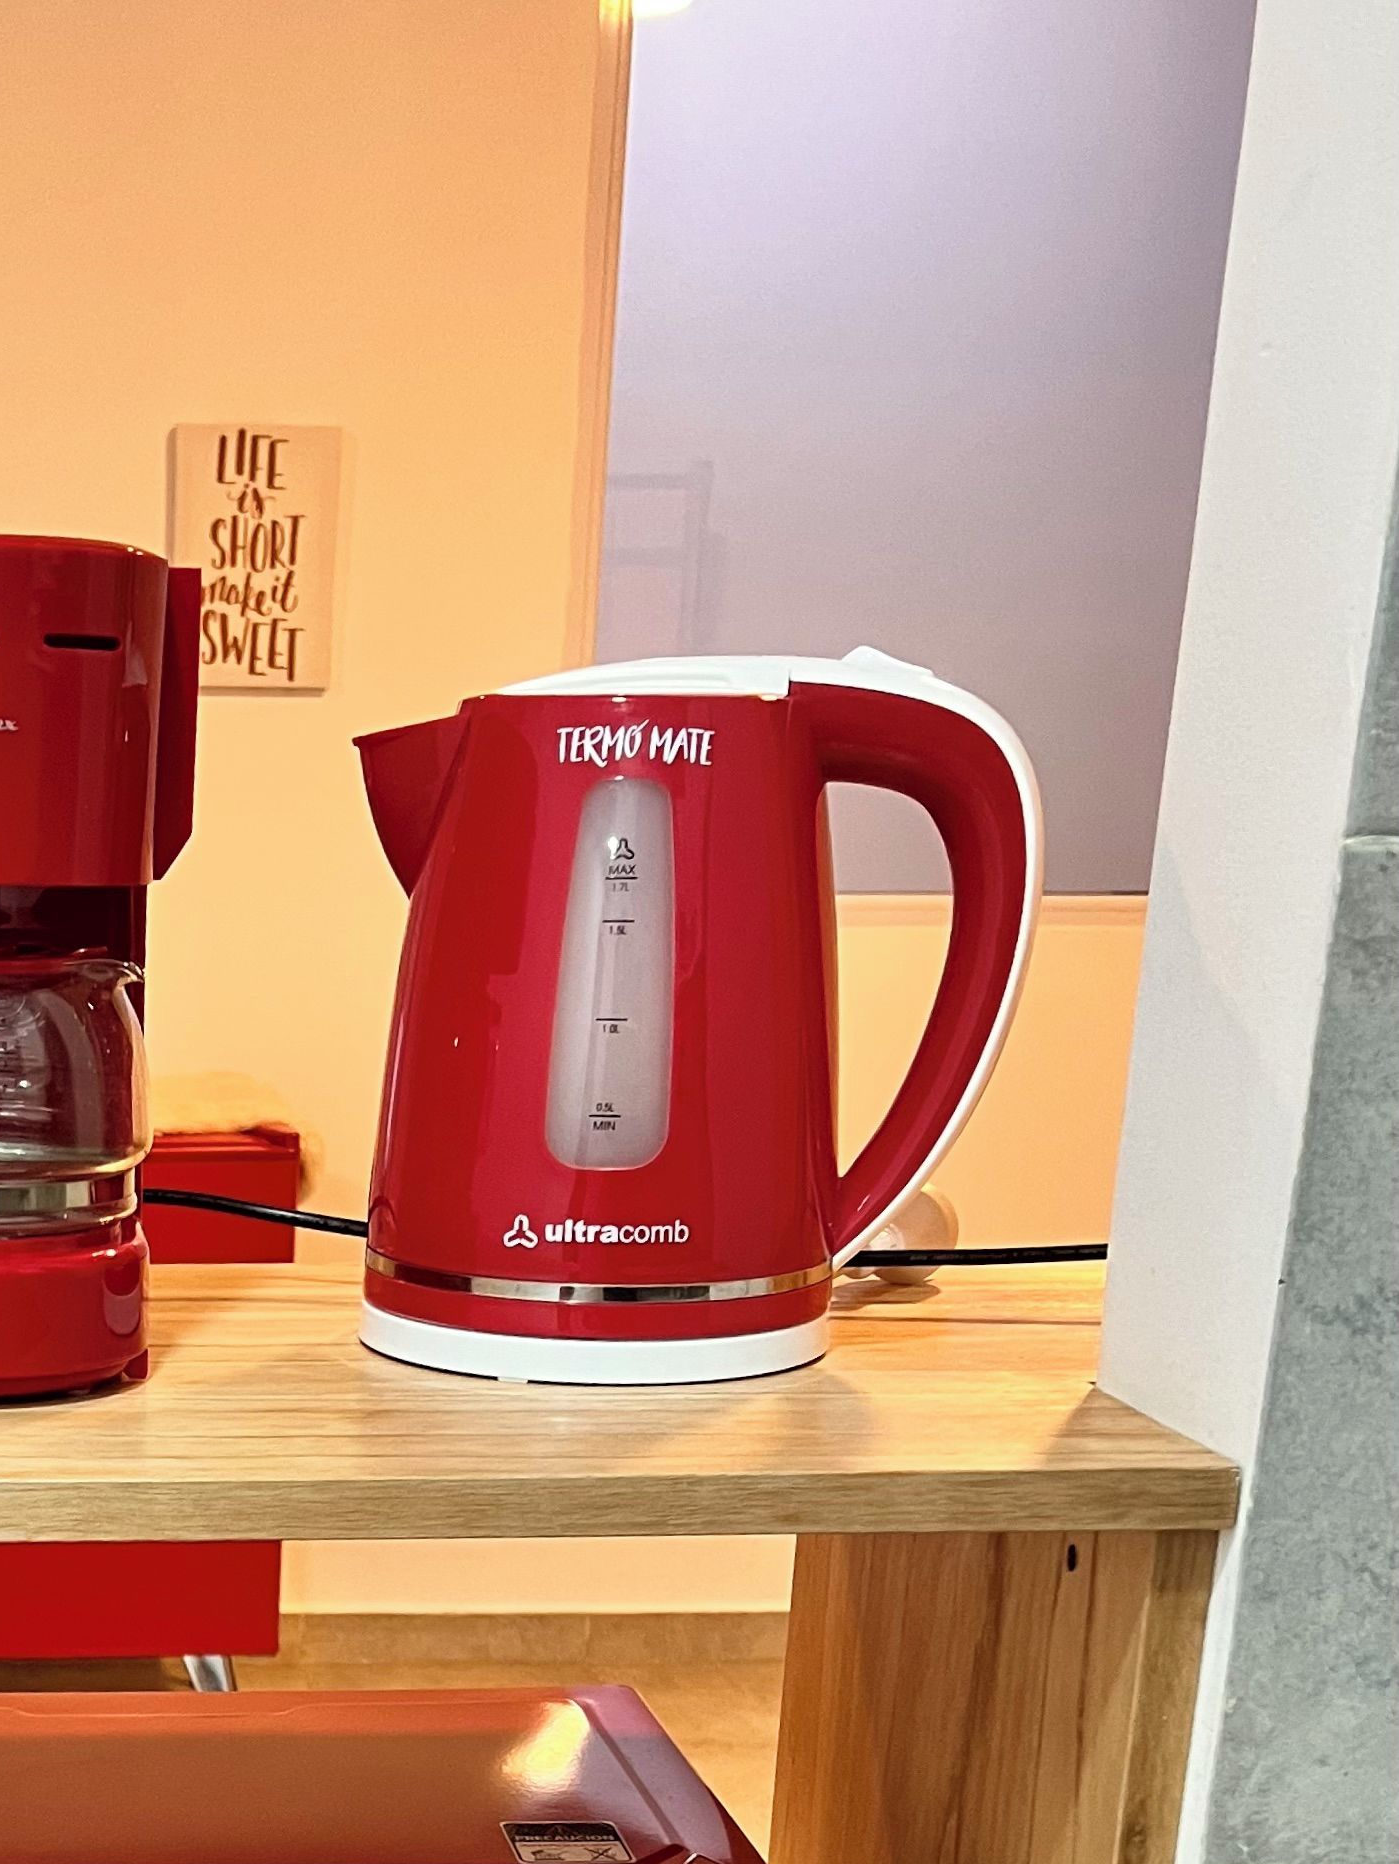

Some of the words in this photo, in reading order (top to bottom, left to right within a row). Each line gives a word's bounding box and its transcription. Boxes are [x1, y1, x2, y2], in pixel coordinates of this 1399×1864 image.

[216, 428, 289, 490] LIFE
[226, 482, 276, 519] is
[208, 514, 306, 573] SHORT
[201, 571, 273, 617] make
[270, 569, 299, 614] it
[201, 609, 306, 682] SWEET
[649, 726, 715, 766] MATE
[608, 864, 637, 876] MAX
[592, 1120, 617, 1132] MIN
[544, 1219, 689, 1244] ultracomb
